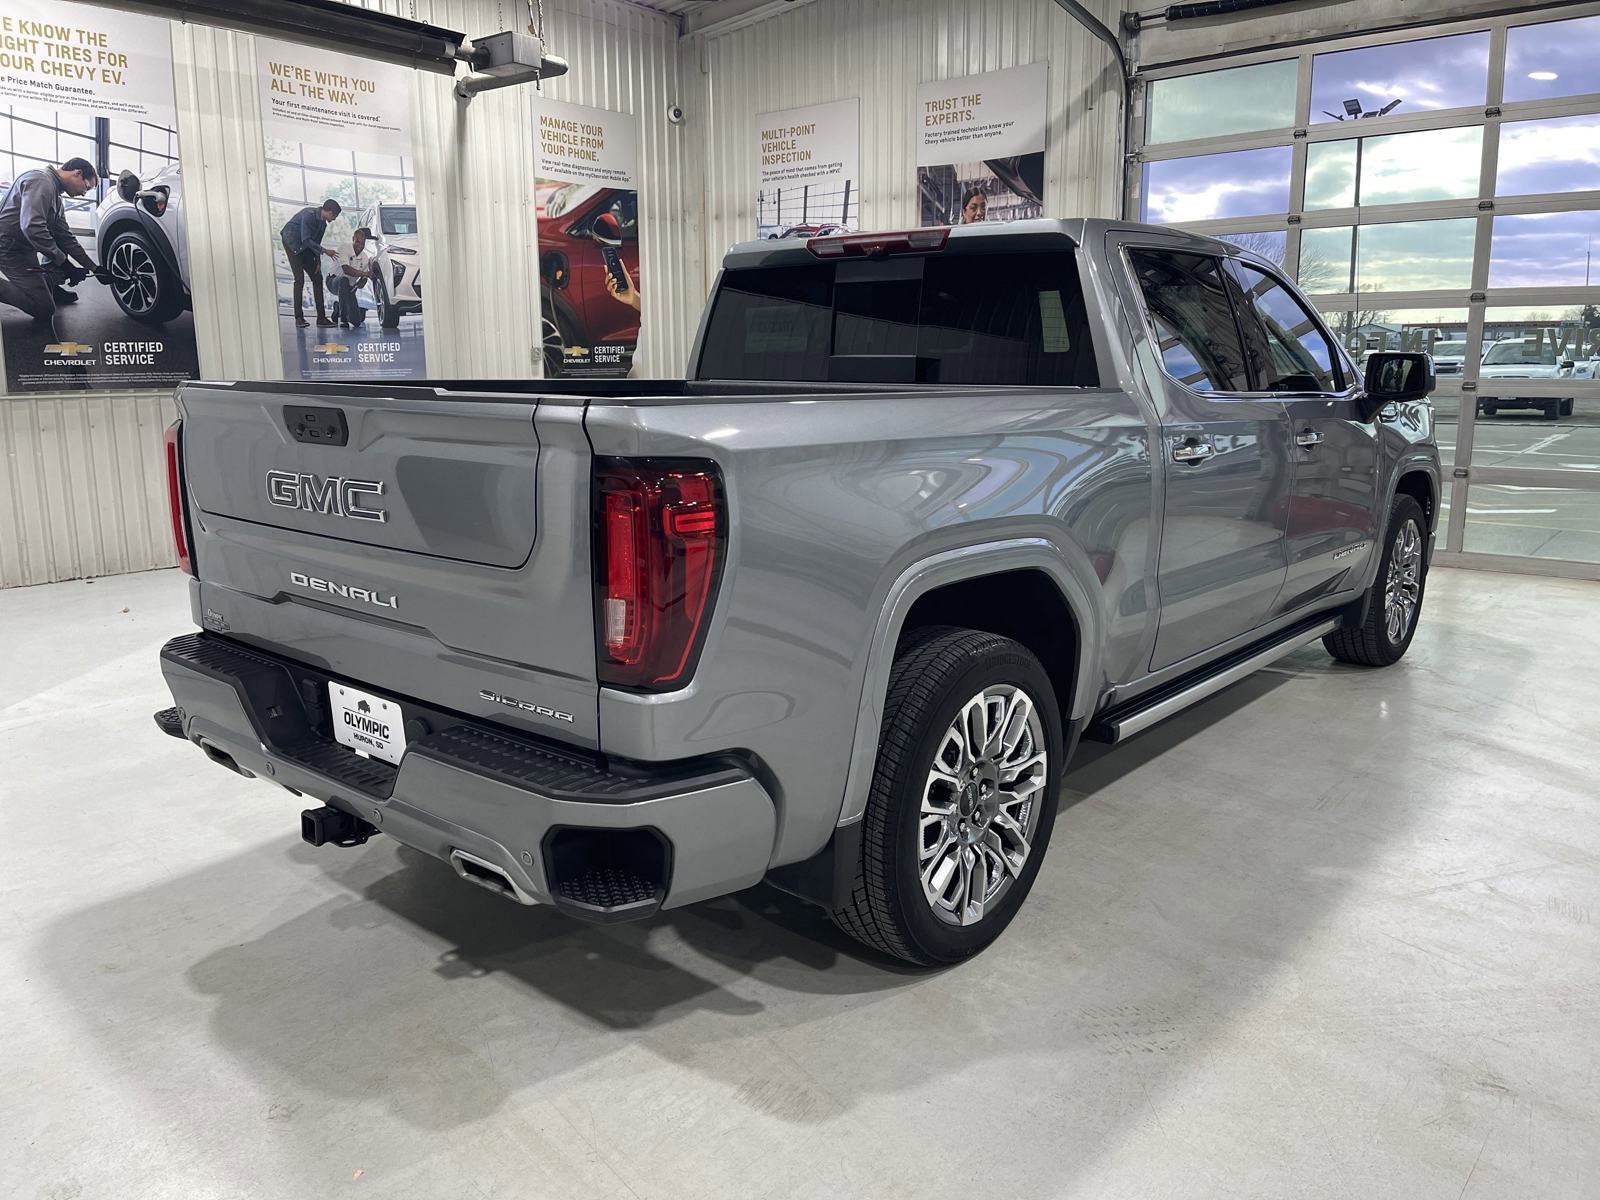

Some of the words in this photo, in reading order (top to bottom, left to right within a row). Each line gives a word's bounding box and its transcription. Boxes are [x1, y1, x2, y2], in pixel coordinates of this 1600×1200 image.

[3, 17, 13, 31] E
[19, 19, 70, 41] KNOW
[76, 29, 108, 48] THE
[0, 34, 38, 54] IGHT
[44, 43, 92, 63] TIRES
[97, 51, 128, 68] FOR
[0, 53, 35, 72] OUR
[41, 60, 96, 81] CHEVY
[101, 70, 126, 86] EV.
[269, 61, 312, 82] WE'RE
[314, 70, 348, 88] WITH
[351, 78, 376, 94] YOU
[7, 76, 28, 86] Price
[29, 79, 53, 90] Match
[55, 83, 95, 96] Guarantee.
[271, 79, 296, 95] ALL
[299, 83, 325, 100] THE
[328, 89, 358, 106] WAY.
[271, 97, 285, 106] Your
[286, 100, 300, 109] first
[301, 104, 338, 116] maintenance
[338, 110, 350, 118] visit
[925, 97, 958, 113] TRUST
[961, 94, 982, 108] THE
[540, 116, 578, 133] MANAGE
[580, 122, 603, 137] YOUR
[925, 109, 975, 127] EXPERTS.
[761, 123, 816, 140] MULTI-POINT
[925, 131, 942, 139] Factory
[961, 125, 988, 134] technicians
[1002, 120, 1015, 129] your
[540, 129, 578, 146] VEHICLE
[580, 136, 604, 150] FROM
[761, 140, 796, 153] VEHICLE
[541, 142, 565, 157] YOUR
[568, 147, 599, 162] PHONE.
[762, 150, 812, 166] INSPECTION
[572, 163, 594, 172] diagnostics
[602, 168, 613, 176] enjoy
[828, 161, 843, 170] getting
[104, 342, 163, 353] CERTIFIED
[357, 342, 400, 352] CERTIFIED
[594, 346, 625, 354] CERTIFIED
[105, 354, 155, 365] SERVICE
[358, 353, 394, 363] SERVICE
[594, 354, 620, 363] SERVICE
[266, 469, 388, 523] GMC
[290, 571, 398, 609] DENALI
[479, 689, 574, 723] SIERRA
[344, 711, 390, 740] OLYMPIC
[353, 732, 375, 748] HURON,
[375, 741, 384, 750] SD
